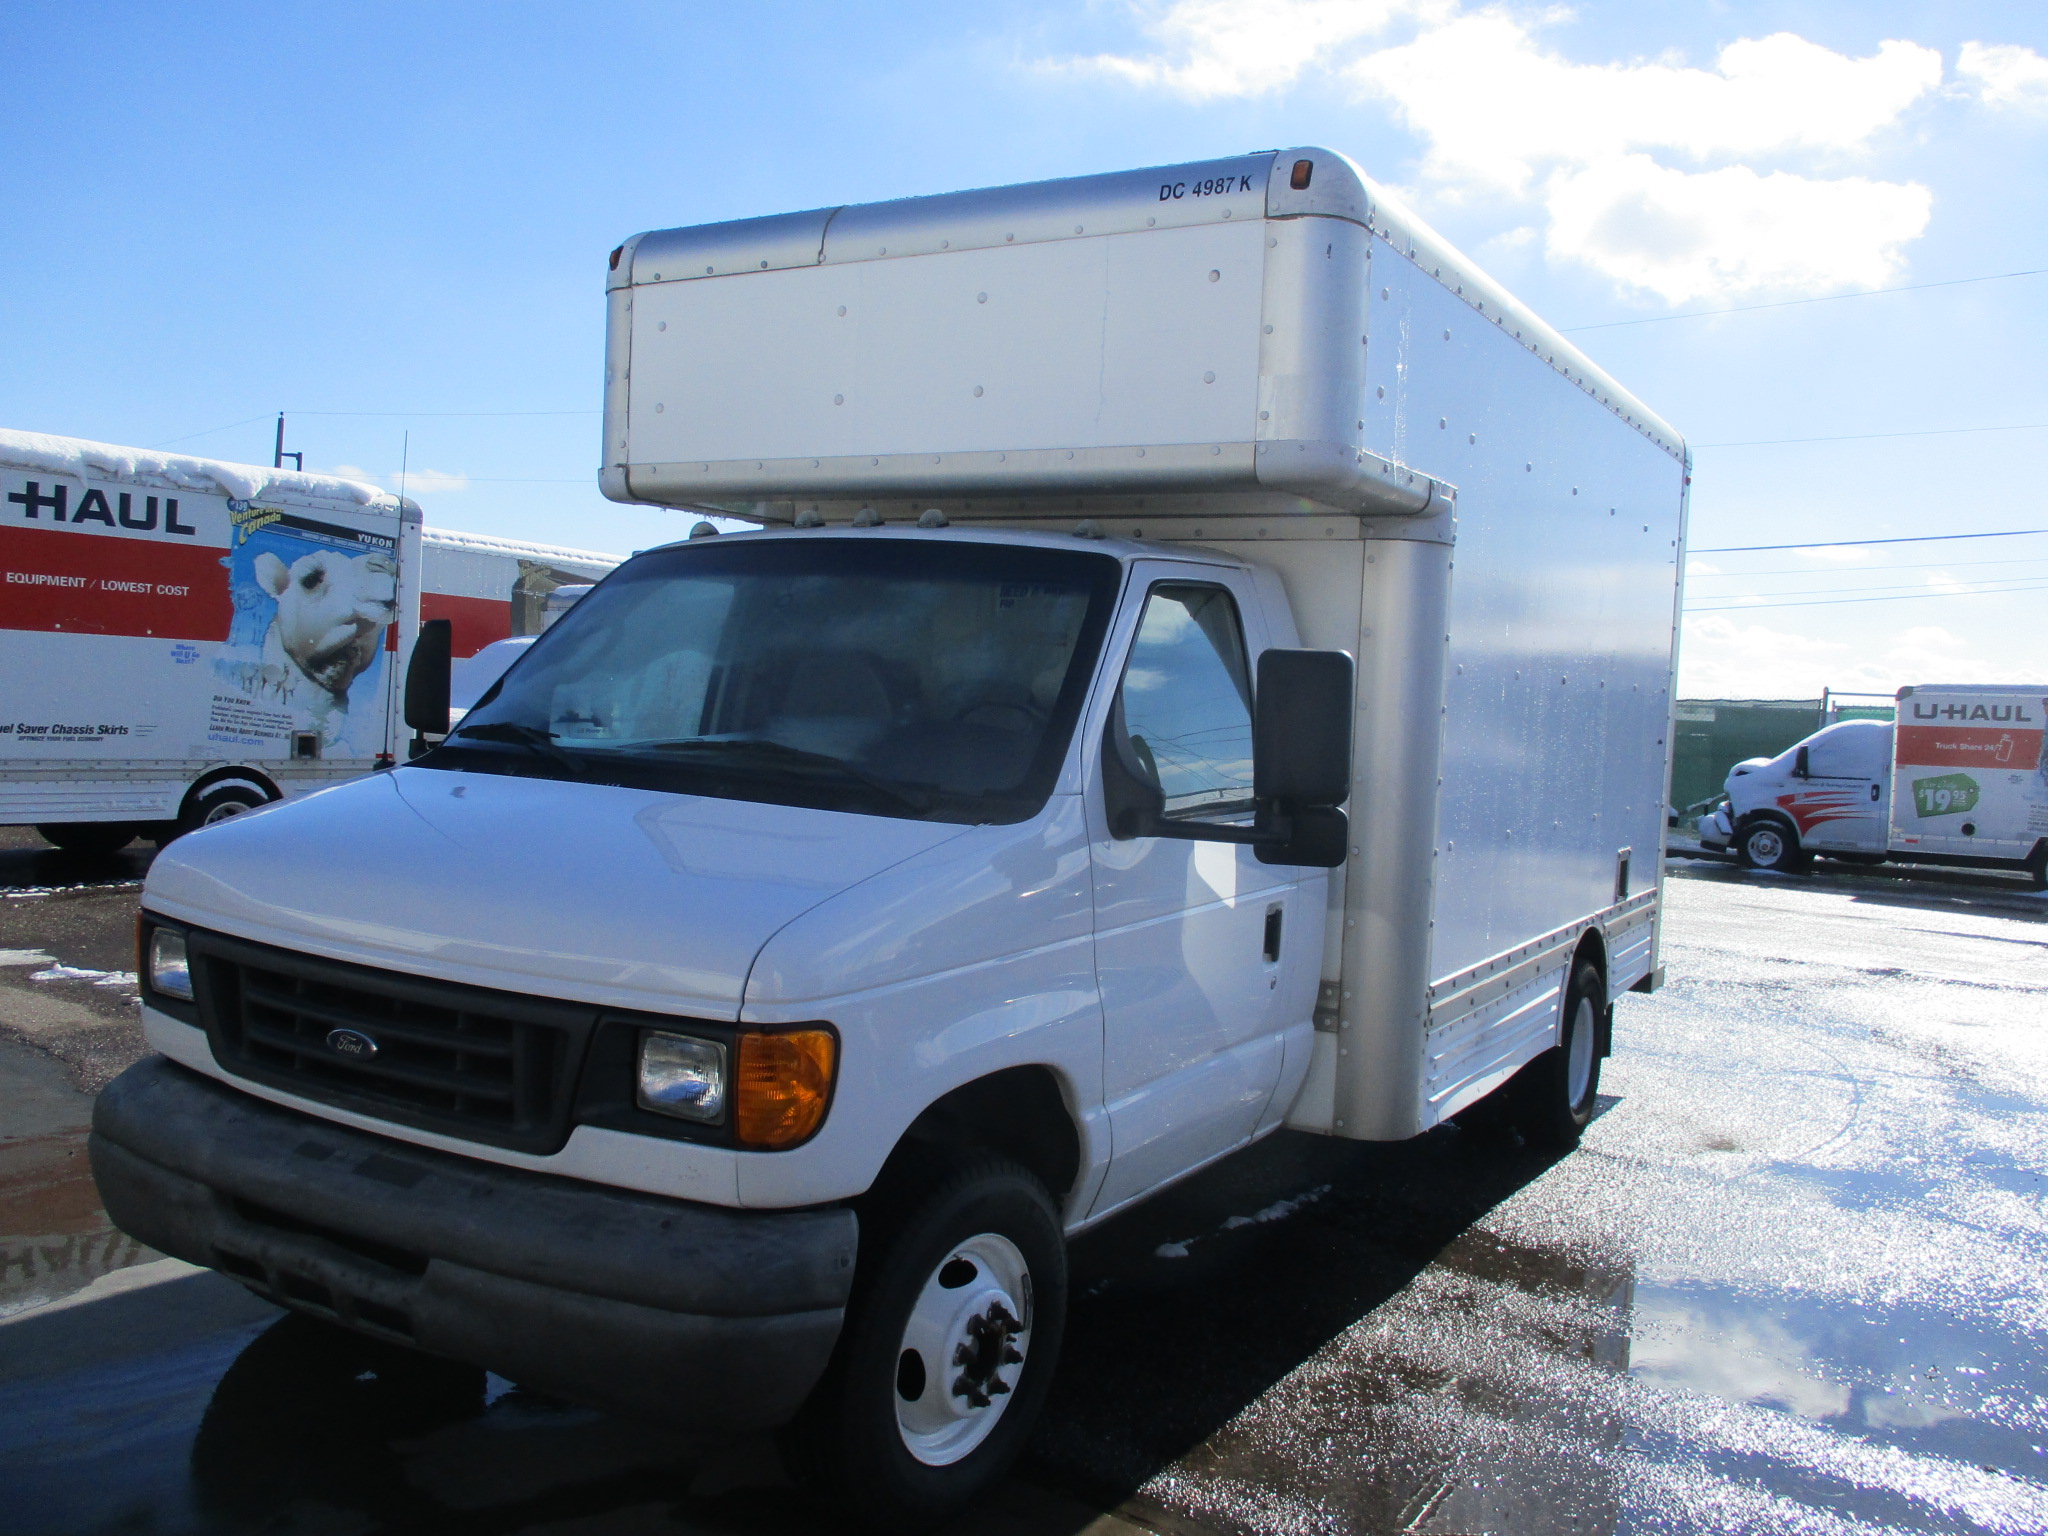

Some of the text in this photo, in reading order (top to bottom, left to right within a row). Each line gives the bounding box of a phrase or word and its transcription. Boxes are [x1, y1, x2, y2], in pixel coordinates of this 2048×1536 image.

[1159, 174, 1252, 201] DC 4987 K
[239, 513, 281, 545] Canada
[358, 533, 393, 548] YUKON
[6, 572, 87, 588] EQUIPMENT
[101, 580, 153, 594] LOWEST
[157, 584, 190, 596] COST
[16, 723, 49, 734] Saver
[51, 724, 95, 735] Chassis
[98, 725, 129, 735] Skirts
[208, 733, 264, 746] uhaul.com
[337, 1034, 362, 1053] Ford
